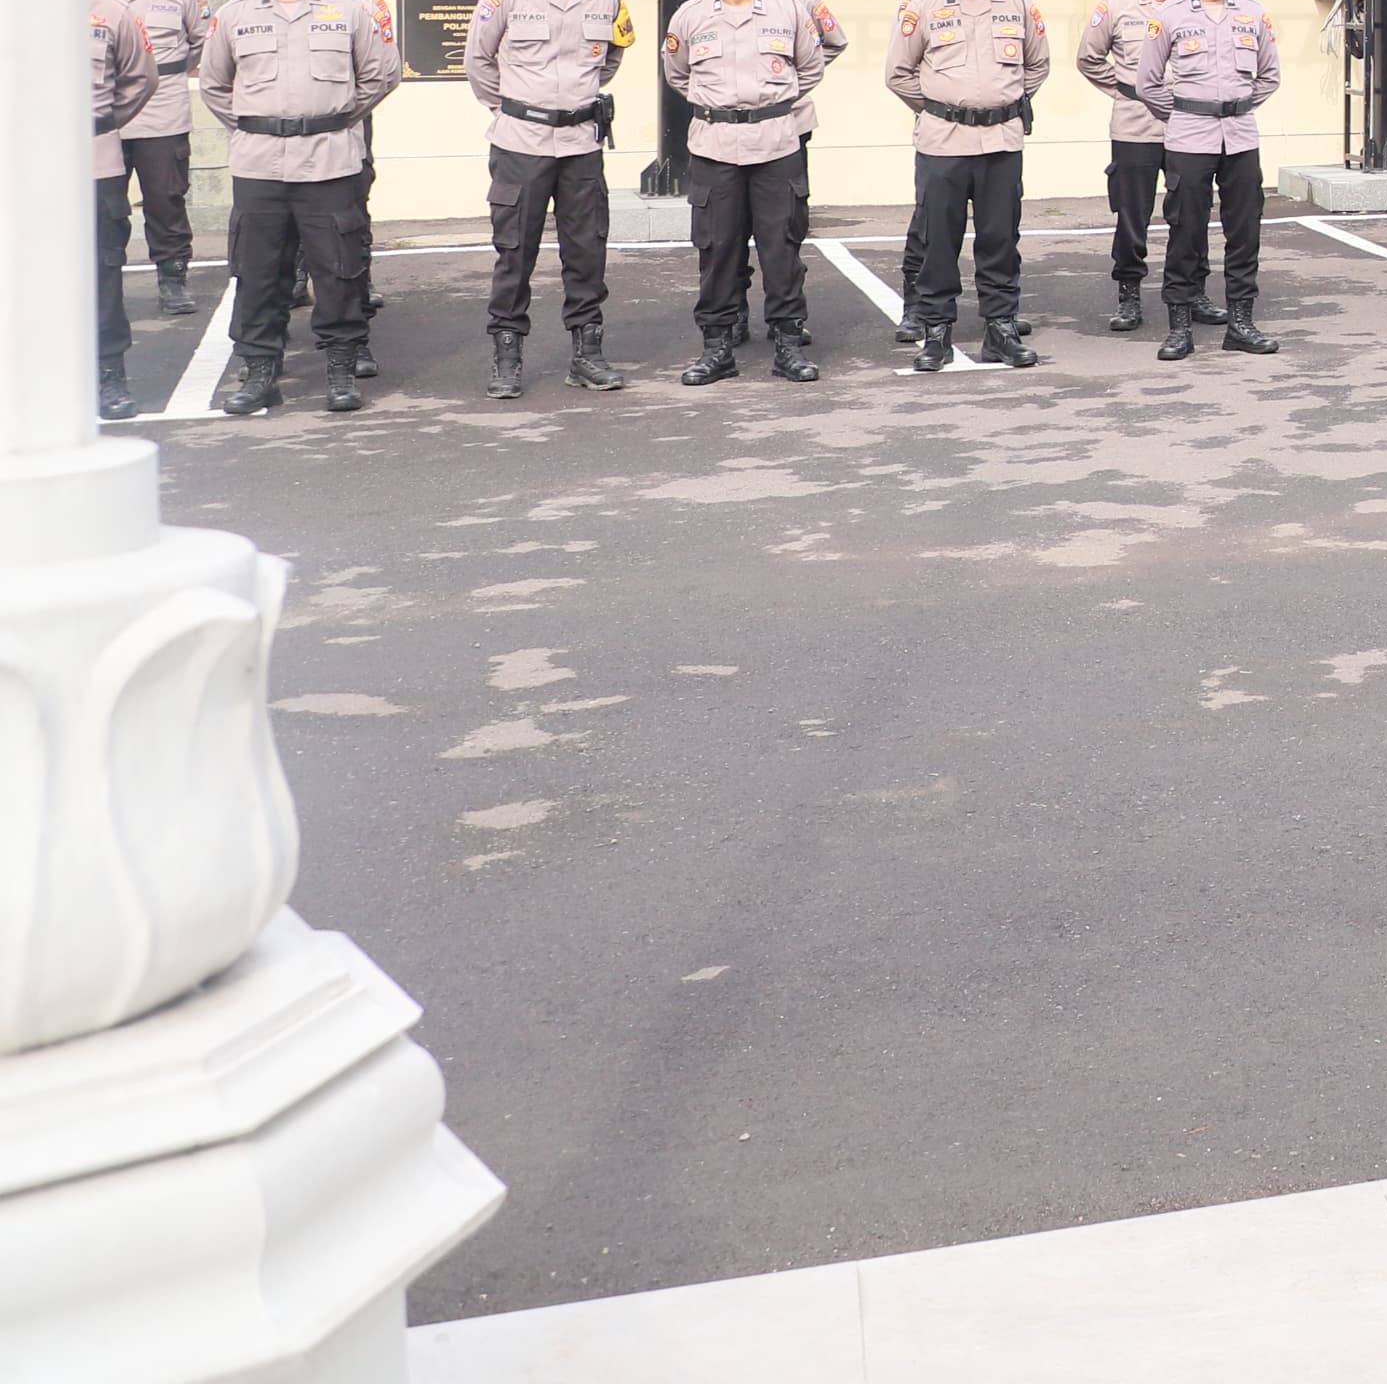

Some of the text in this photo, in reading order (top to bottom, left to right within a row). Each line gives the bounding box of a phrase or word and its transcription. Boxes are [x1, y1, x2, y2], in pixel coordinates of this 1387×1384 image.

[512, 13, 546, 21] RIYADI
[992, 14, 1021, 23] POLRI
[237, 24, 273, 36] MASTUR
[311, 23, 347, 32] POLRI
[762, 27, 793, 36] POLRI
[1232, 25, 1257, 35] POLRI
[1176, 28, 1206, 40] RIYAN
